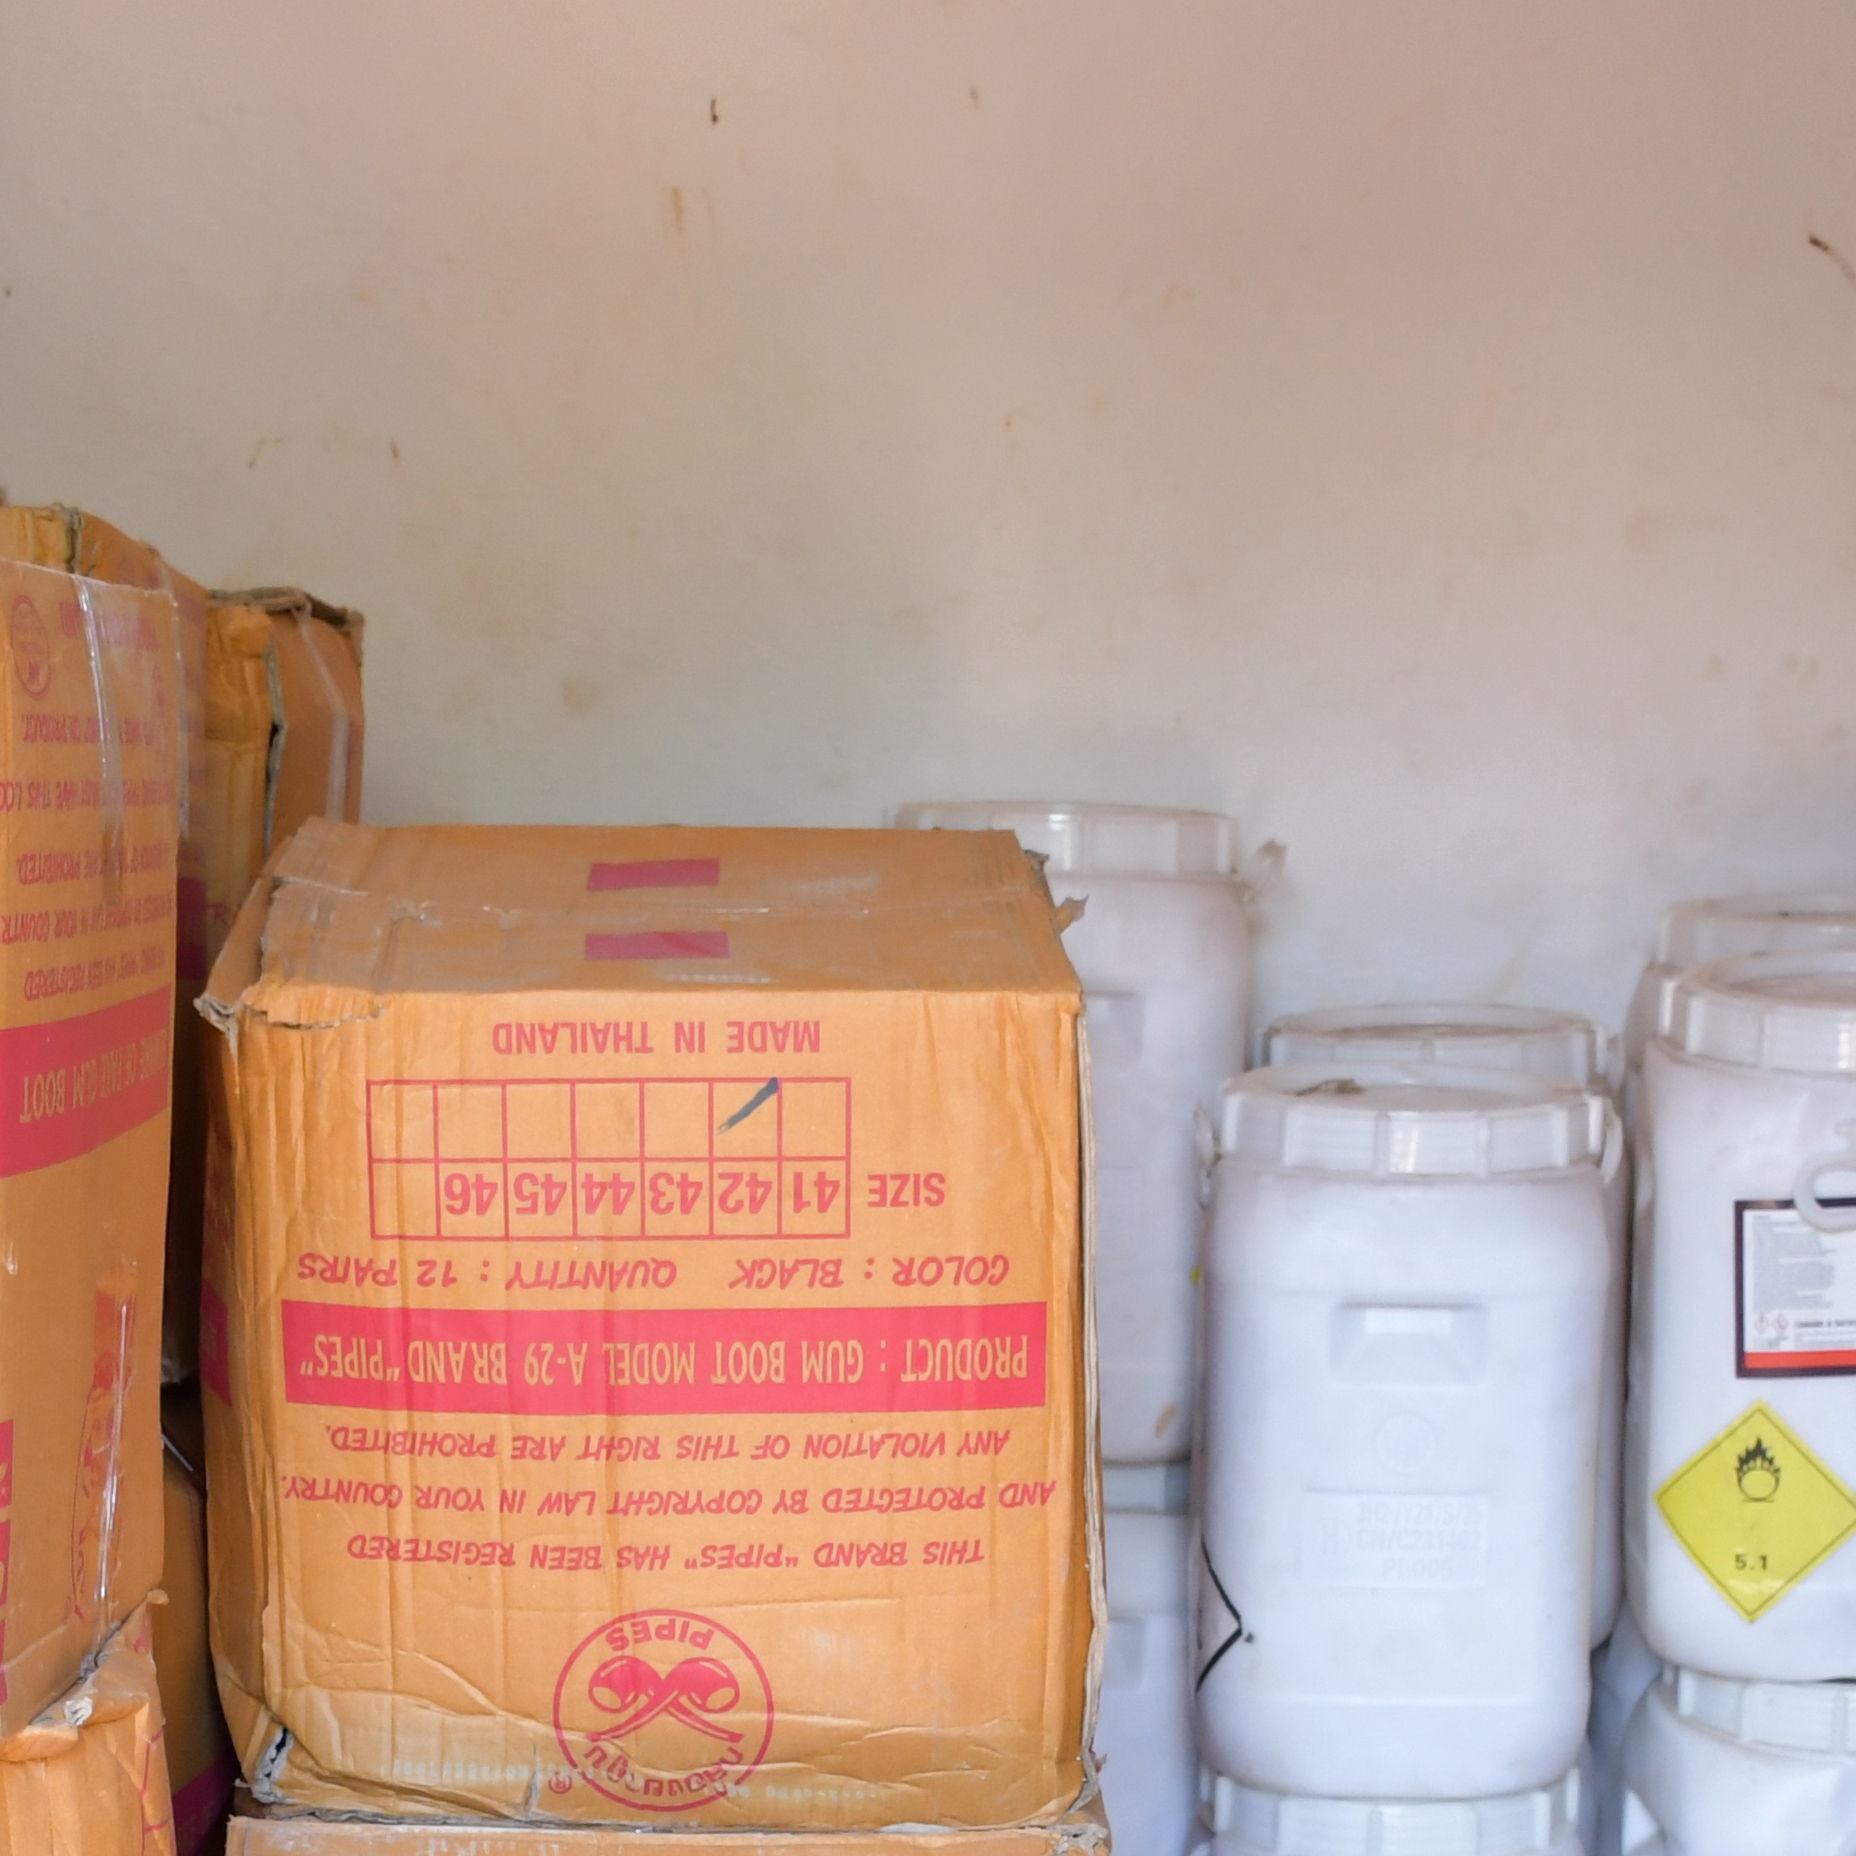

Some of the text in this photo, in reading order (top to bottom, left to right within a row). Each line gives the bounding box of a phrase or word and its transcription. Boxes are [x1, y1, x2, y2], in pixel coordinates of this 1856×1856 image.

[491, 1020, 822, 1055] MADE IN THAILAND
[19, 1071, 66, 1125] BOOT
[443, 1170, 946, 1216] SIZE 41 42 43 44 45 46
[297, 1251, 1011, 1293] COLOR BLACK QUANTITY 12 PAIRS
[407, 1339, 507, 1385] BRAND
[523, 1341, 588, 1386] A-29
[602, 1341, 696, 1387] MODEL
[711, 1339, 786, 1385] BOOT
[801, 1339, 865, 1384] GUM
[900, 1336, 1029, 1383] PRODUCT
[602, 1612, 716, 1653] PIPES
